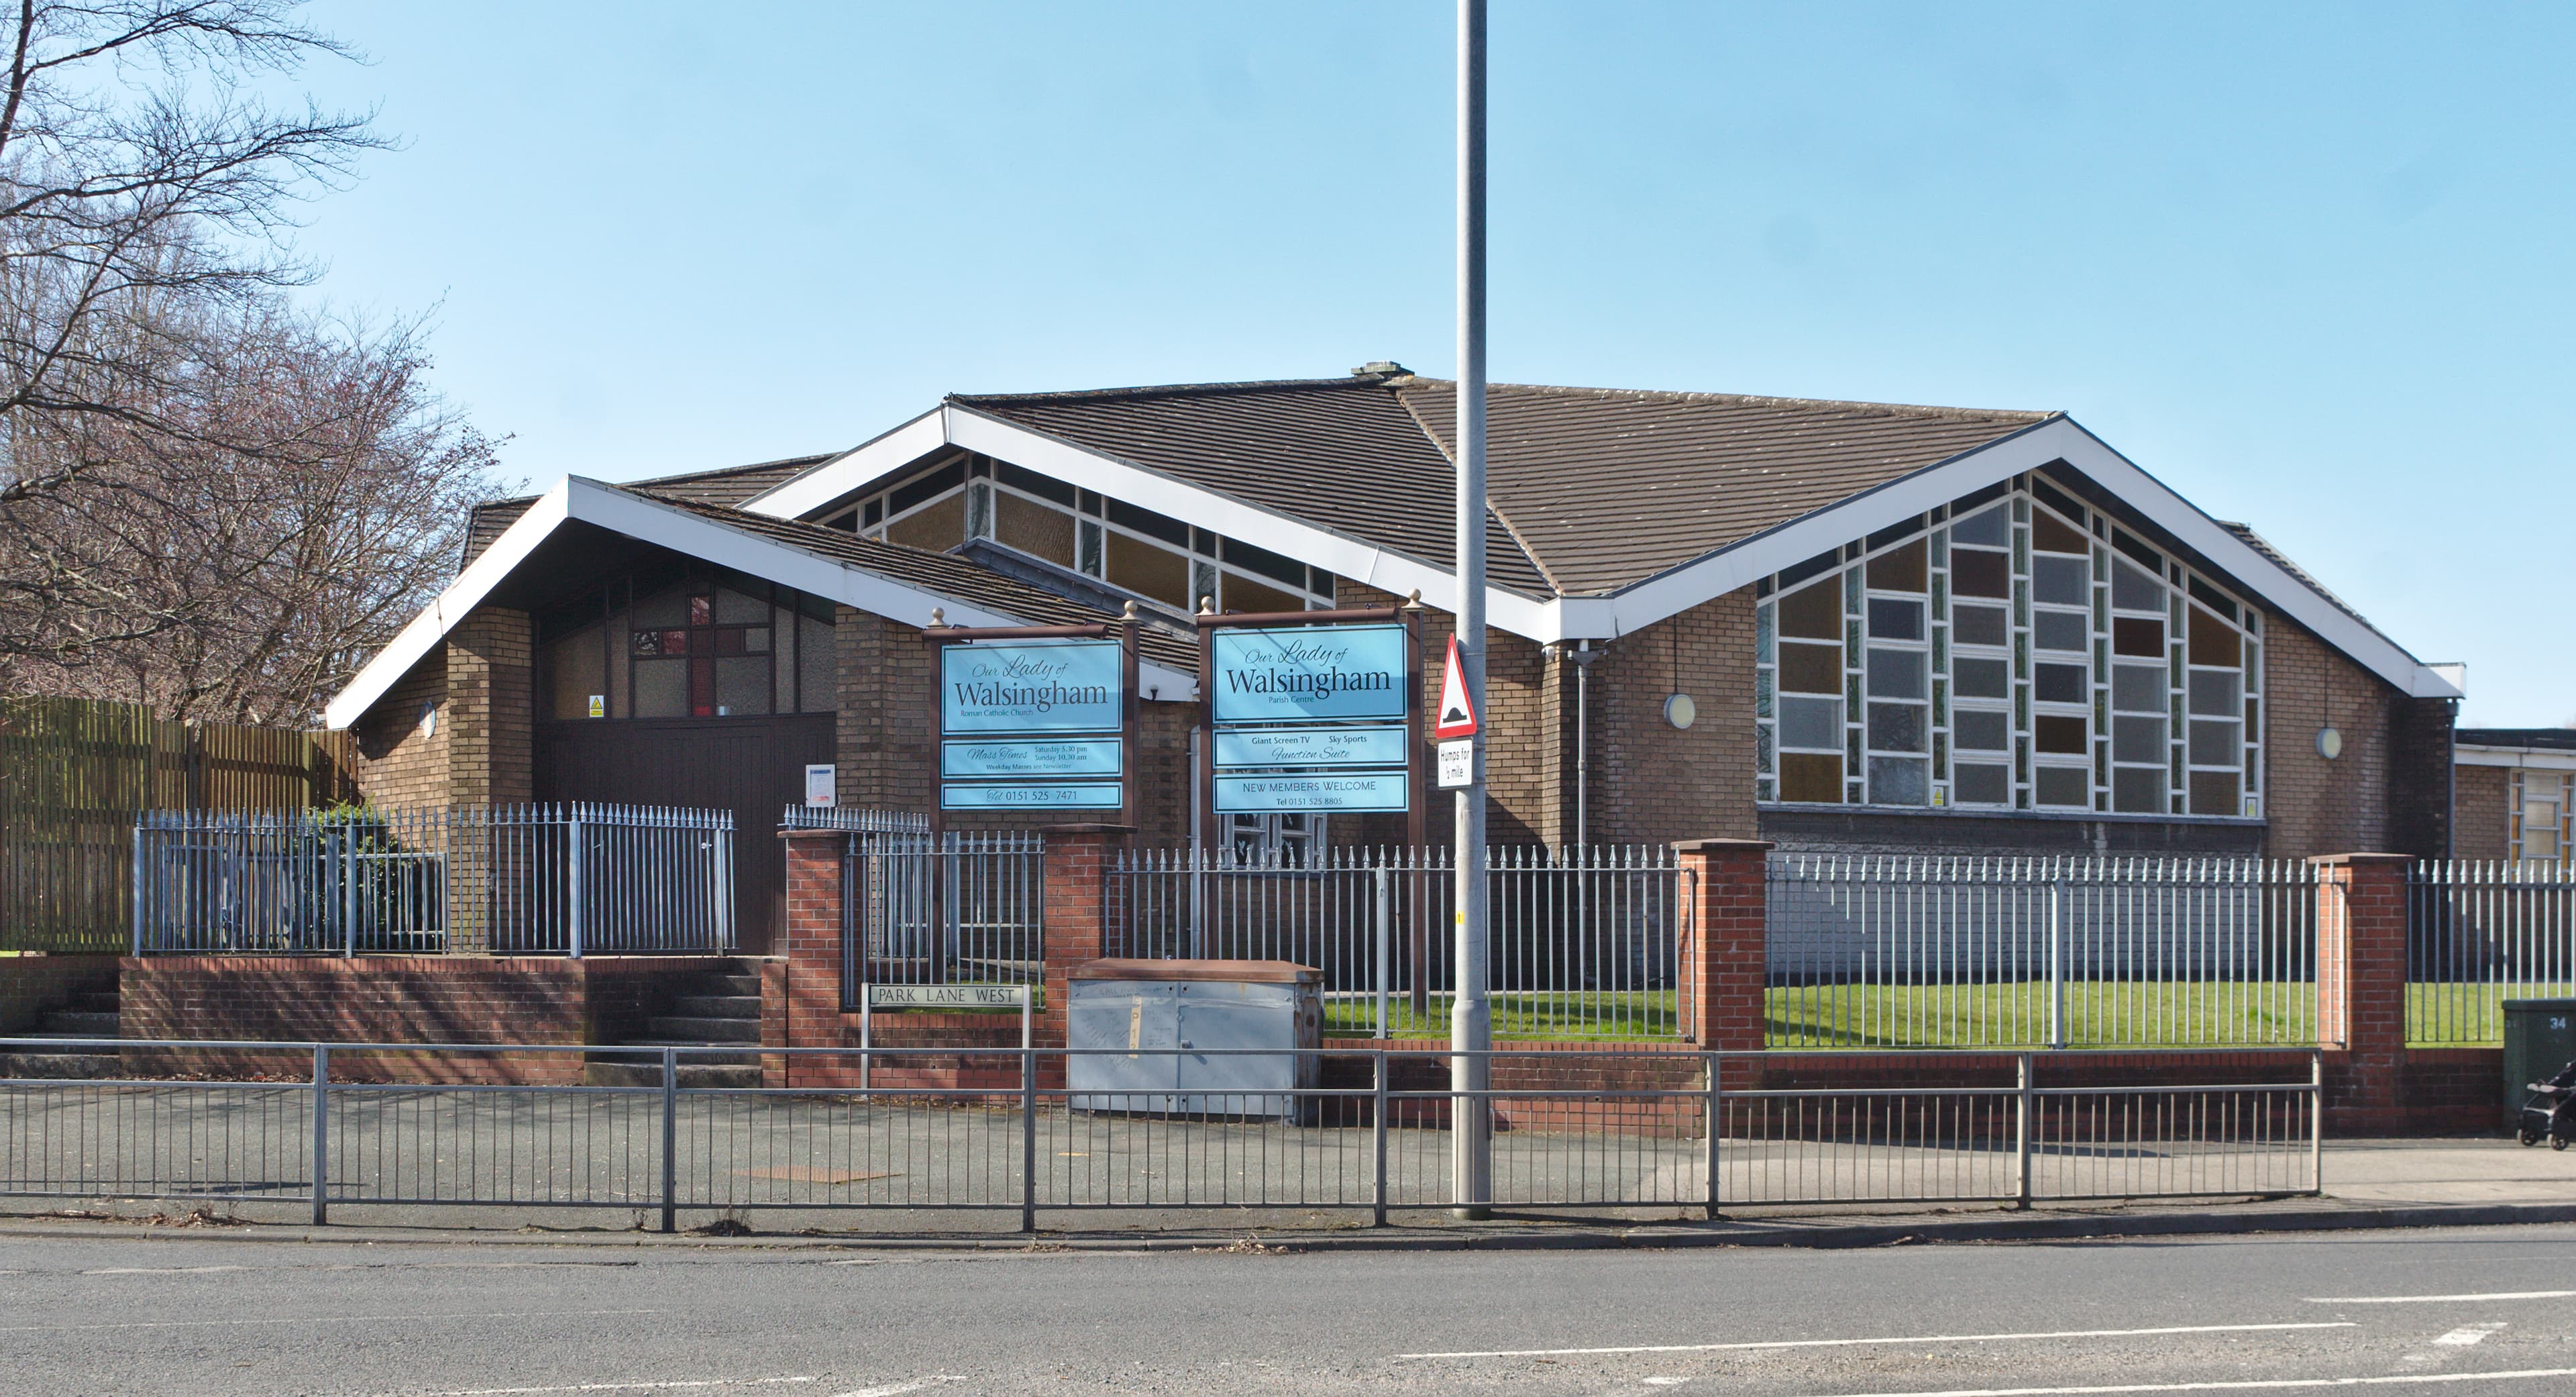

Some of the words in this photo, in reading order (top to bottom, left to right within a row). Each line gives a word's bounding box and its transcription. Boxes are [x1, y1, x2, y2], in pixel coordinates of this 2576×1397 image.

[1245, 650, 1273, 664] Our
[1277, 639, 1332, 666] Lady
[1335, 648, 1348, 664] of
[972, 664, 999, 678] Our
[1003, 654, 1053, 680] Lady
[1056, 663, 1068, 677] of
[1226, 666, 1392, 699] Walsingham
[955, 680, 1108, 713] Walsingham
[1329, 736, 1341, 745] Sky
[1344, 735, 1367, 744] Sports
[967, 748, 997, 760] Mass
[999, 747, 1028, 760] Times
[1271, 747, 1317, 760] Function
[1319, 747, 1350, 760] Suite
[1440, 749, 1459, 762] Humps
[1462, 747, 1470, 760] for
[1452, 765, 1463, 778] mile
[1243, 783, 1267, 792] NEW
[1269, 782, 1320, 792] MEMBERS
[1323, 781, 1376, 790] WELCOME
[1006, 791, 1028, 800] 0151
[1032, 791, 1049, 800] 525
[1056, 790, 1077, 800] 7471
[879, 988, 916, 1002] PARK
[926, 989, 965, 1002] LANE
[975, 989, 1014, 1002] WEST
[2550, 1017, 2566, 1029] 34
